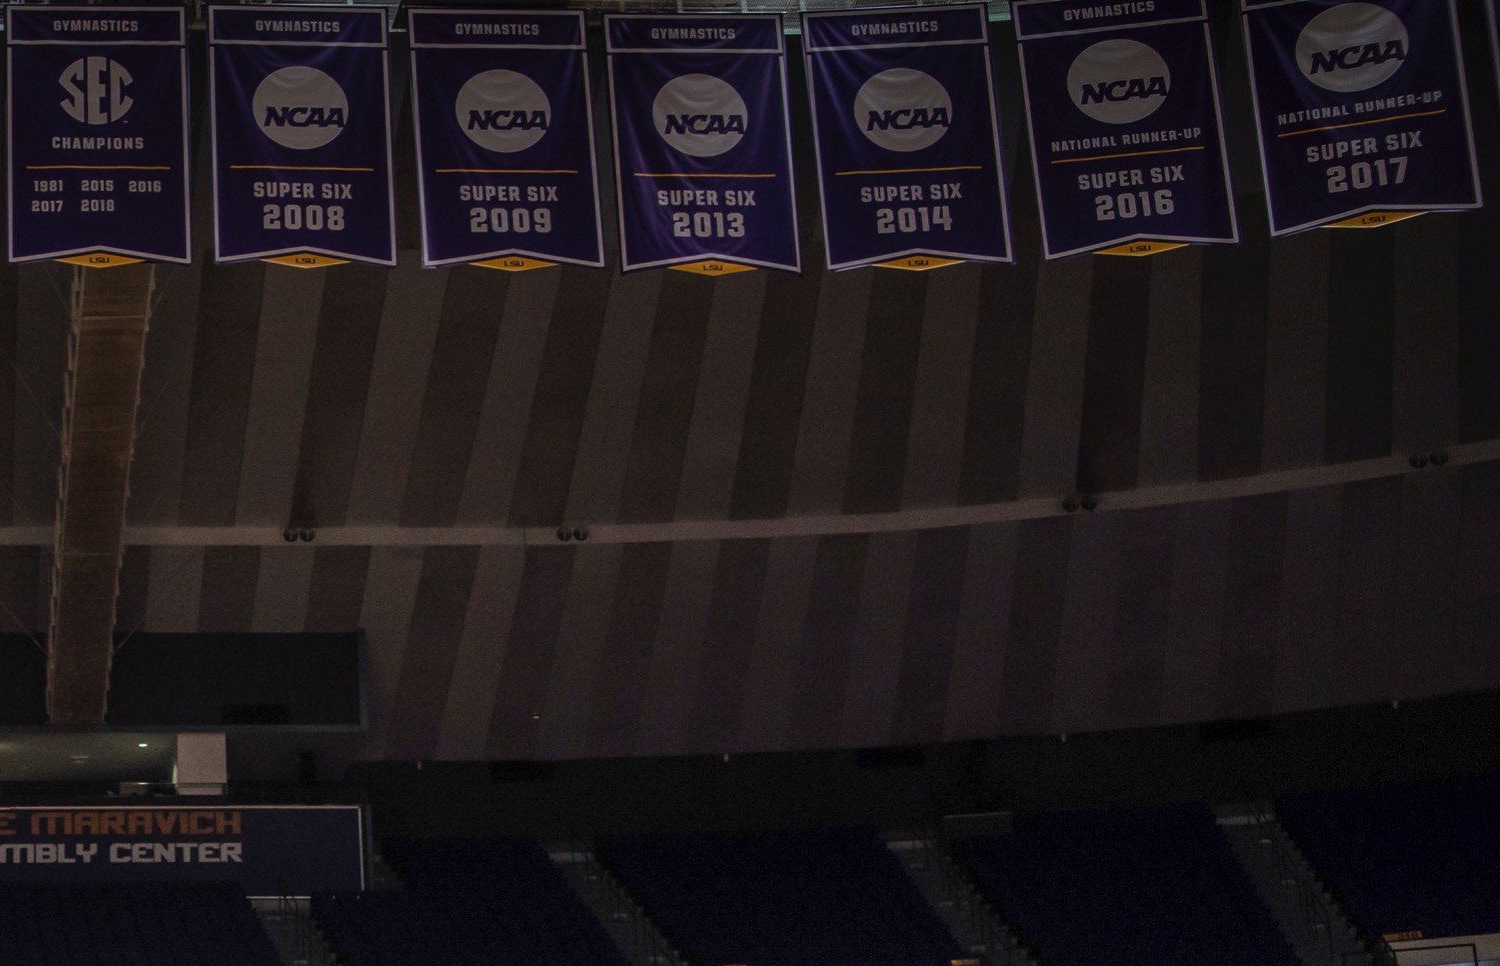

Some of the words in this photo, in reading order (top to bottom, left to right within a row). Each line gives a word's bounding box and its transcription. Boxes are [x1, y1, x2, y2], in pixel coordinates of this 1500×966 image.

[1064, 0, 1155, 21] GYMNASTICS
[53, 20, 139, 32] GYMNASTICS
[255, 20, 340, 32] GYMNASTICS
[455, 23, 539, 35] GYMNASTICS
[651, 28, 736, 39] GYMNASTICS
[851, 21, 938, 36] GYMNASTICS
[1310, 39, 1406, 74] NCAA
[58, 56, 134, 125] SEC
[1081, 77, 1169, 105] NCAA
[264, 107, 346, 127] NCAA
[867, 107, 950, 131] NCAA
[1278, 105, 1349, 126] NATIONAL
[1355, 91, 1442, 113] RUNNER-UP
[468, 110, 548, 130] NCAA
[665, 114, 746, 135] NCAA
[52, 137, 144, 150] CHAMPIONS
[1051, 136, 1117, 152] NATIONAL
[1122, 127, 1201, 145] RUNNER-UP
[1306, 138, 1378, 162] SUPER
[1386, 131, 1423, 151] SIX
[1078, 169, 1143, 190] SUPER
[1150, 165, 1184, 184] SIX
[1326, 156, 1408, 193] 2017
[34, 180, 63, 192] 1981
[81, 180, 114, 192] 2015
[129, 180, 162, 192] 2016
[253, 182, 315, 198] SUPER
[322, 184, 353, 199] SIX
[460, 185, 521, 201] SUPER
[527, 186, 558, 201] SIX
[860, 185, 923, 203] SUPER
[930, 183, 962, 200] SIX
[31, 200, 63, 212] 2017
[81, 200, 115, 212] 2018
[657, 190, 719, 206] SUPER
[725, 190, 756, 206] SIX
[1095, 189, 1174, 221] 2016
[263, 204, 345, 231] 2008
[470, 207, 552, 233] 2009
[672, 212, 745, 238] 2013
[876, 206, 953, 234] 2014
[31, 812, 241, 836] MARAVICH
[110, 843, 242, 863] CENTER
